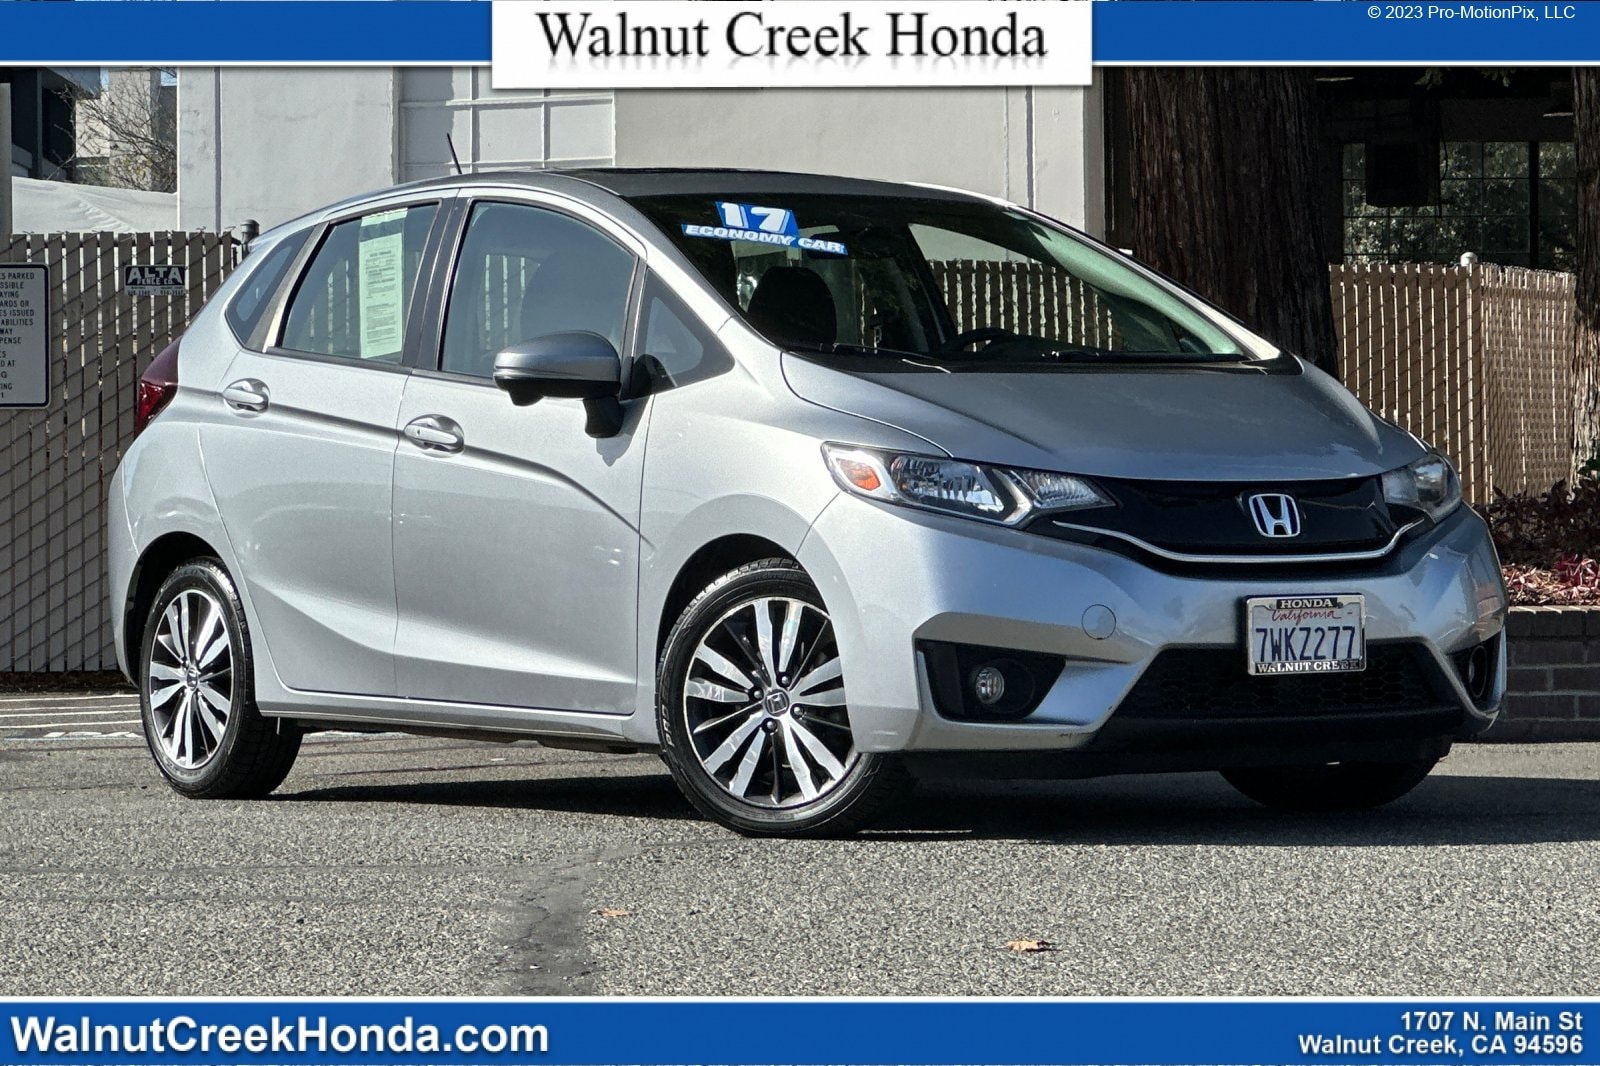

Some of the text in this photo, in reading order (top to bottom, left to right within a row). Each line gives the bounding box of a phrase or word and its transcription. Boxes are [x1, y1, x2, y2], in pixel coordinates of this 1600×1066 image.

[721, 202, 791, 233] 17
[685, 224, 846, 254] ECONOMY CAR
[8, 272, 35, 280] PARKED
[127, 267, 183, 285] ALTA
[20, 300, 30, 308] OR
[10, 309, 35, 317] ISSUED
[1280, 598, 1334, 609] HONDA
[1271, 607, 1342, 626] California
[1255, 625, 1356, 662] 7WKZ277
[1257, 661, 1312, 674] WALNUT
